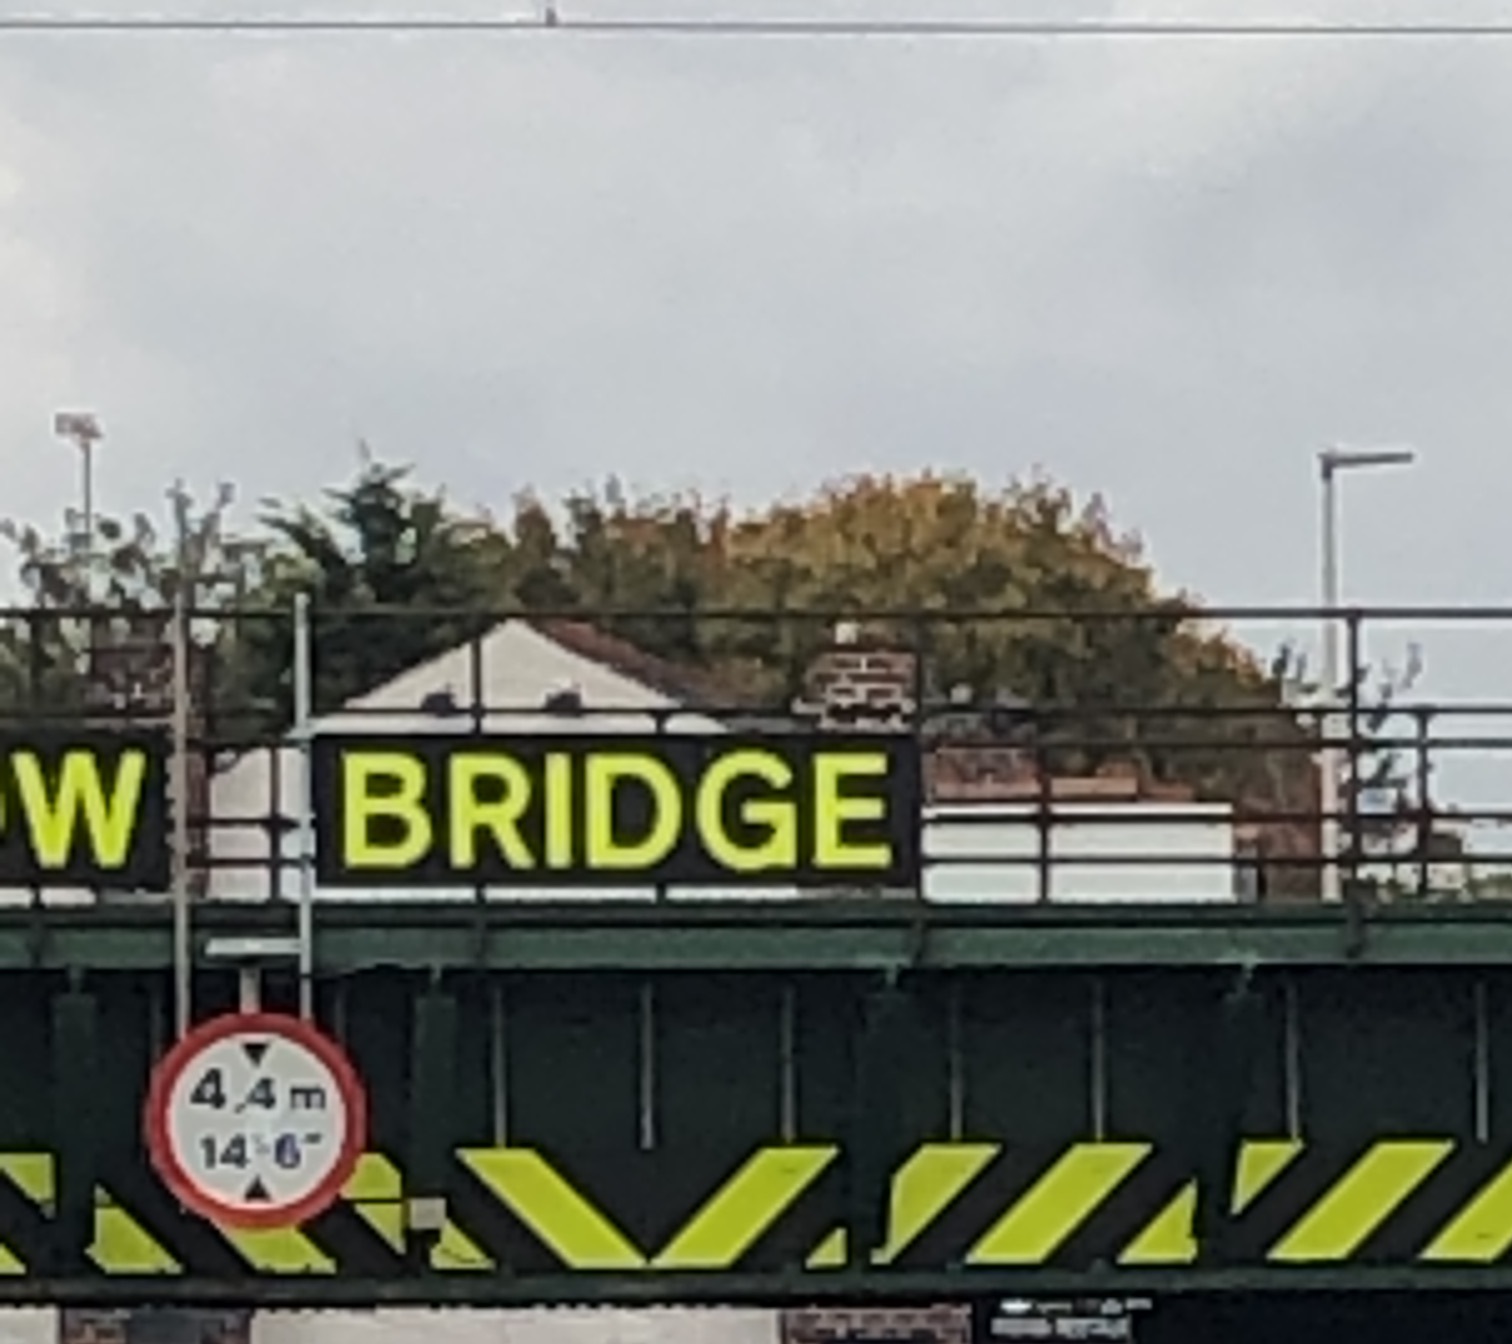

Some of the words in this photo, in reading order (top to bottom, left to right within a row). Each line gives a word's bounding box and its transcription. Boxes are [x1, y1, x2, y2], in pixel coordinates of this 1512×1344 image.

[0, 750, 147, 869] W
[343, 749, 892, 872] BRIDGE
[290, 1085, 327, 1110] m
